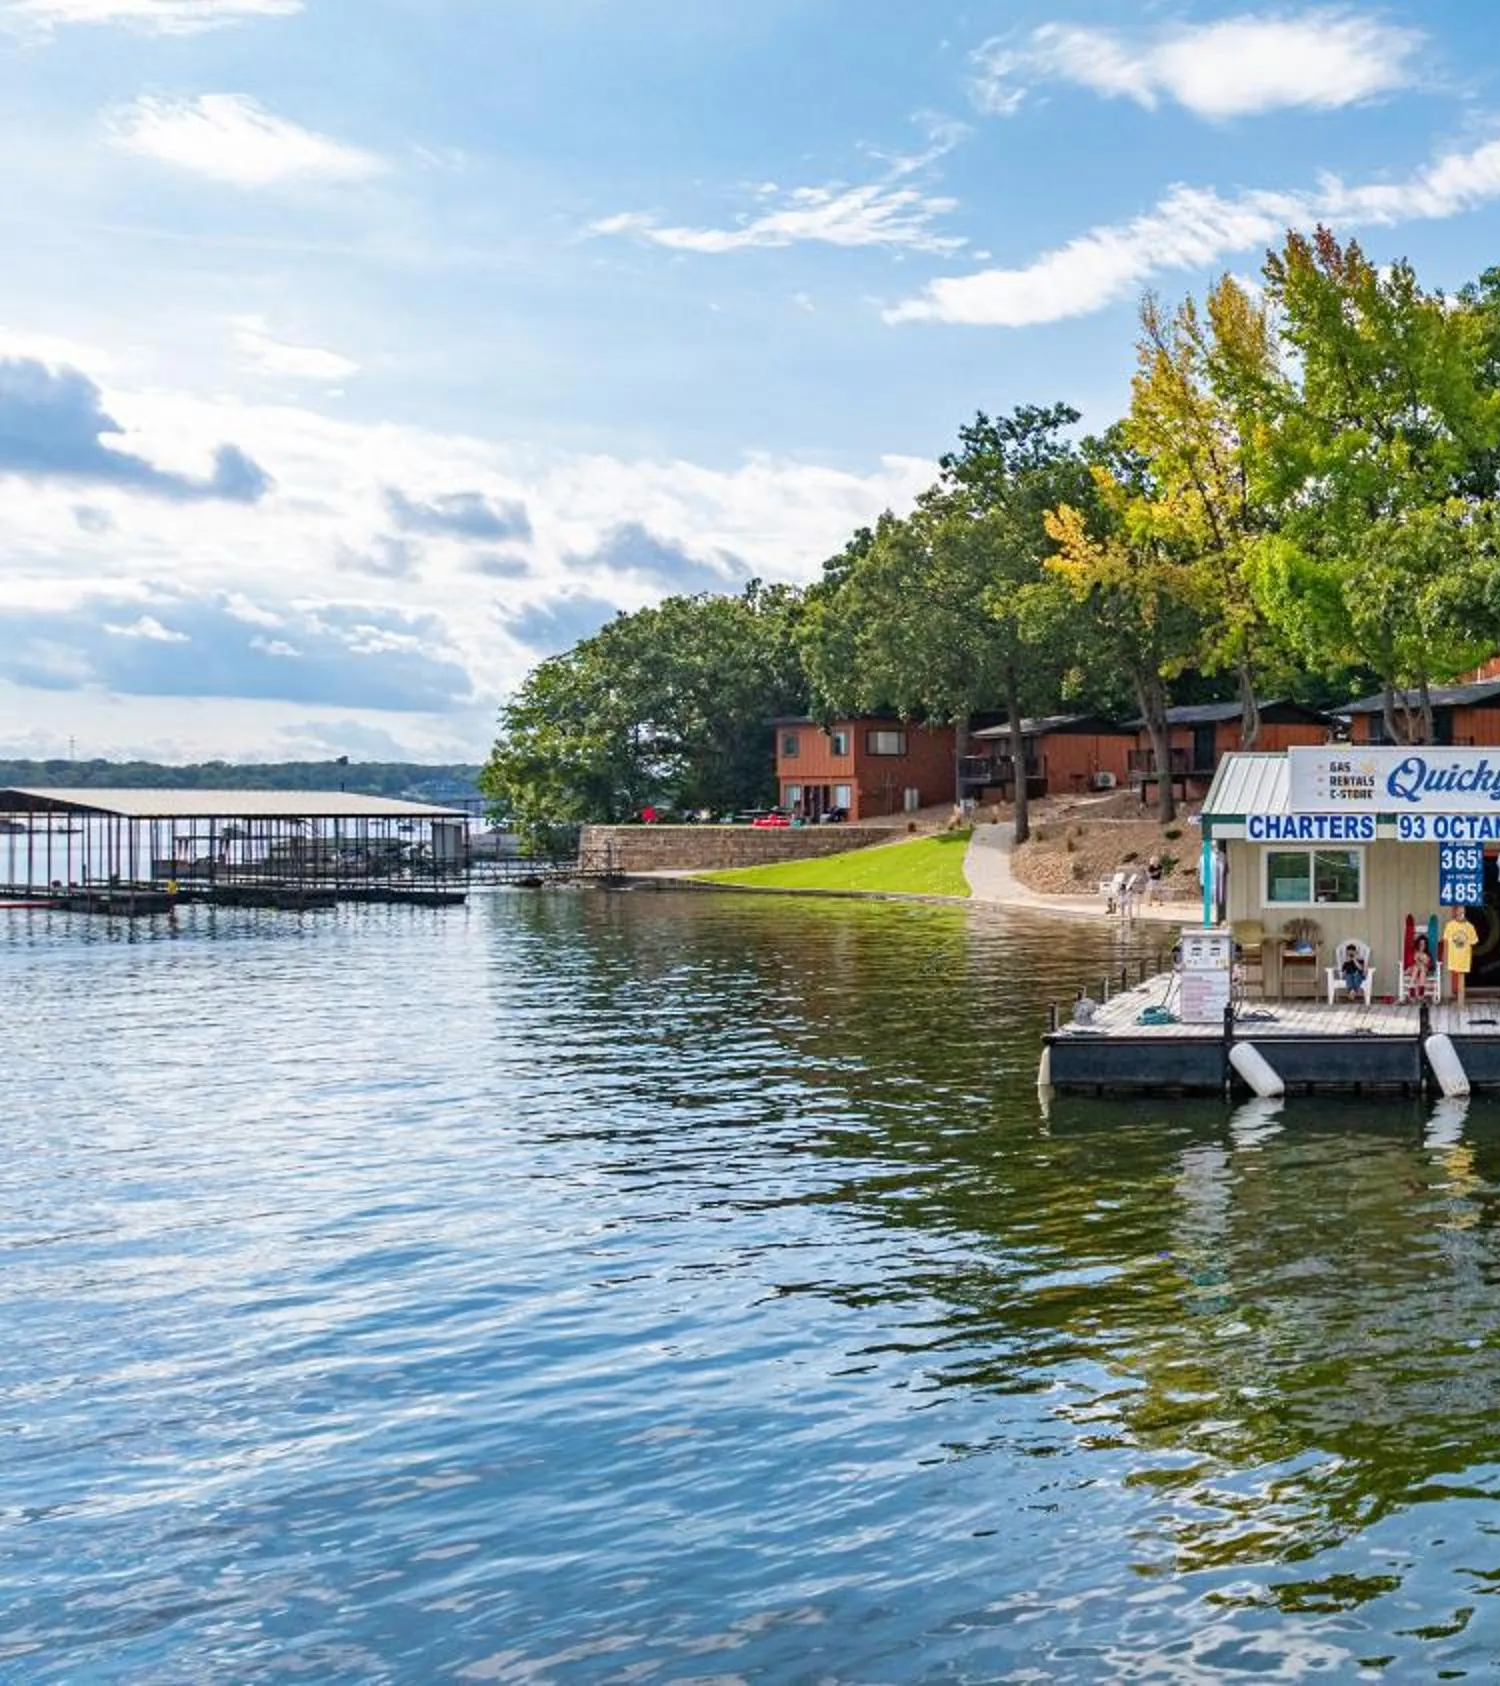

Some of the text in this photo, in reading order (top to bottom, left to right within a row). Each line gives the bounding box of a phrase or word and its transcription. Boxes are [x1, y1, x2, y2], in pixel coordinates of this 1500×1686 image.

[1329, 761, 1351, 773] GAS
[1329, 775, 1375, 787] RENTALS
[1330, 789, 1374, 799] C-STORE
[1249, 815, 1374, 839] CHARTERS
[1399, 815, 1425, 839] 93
